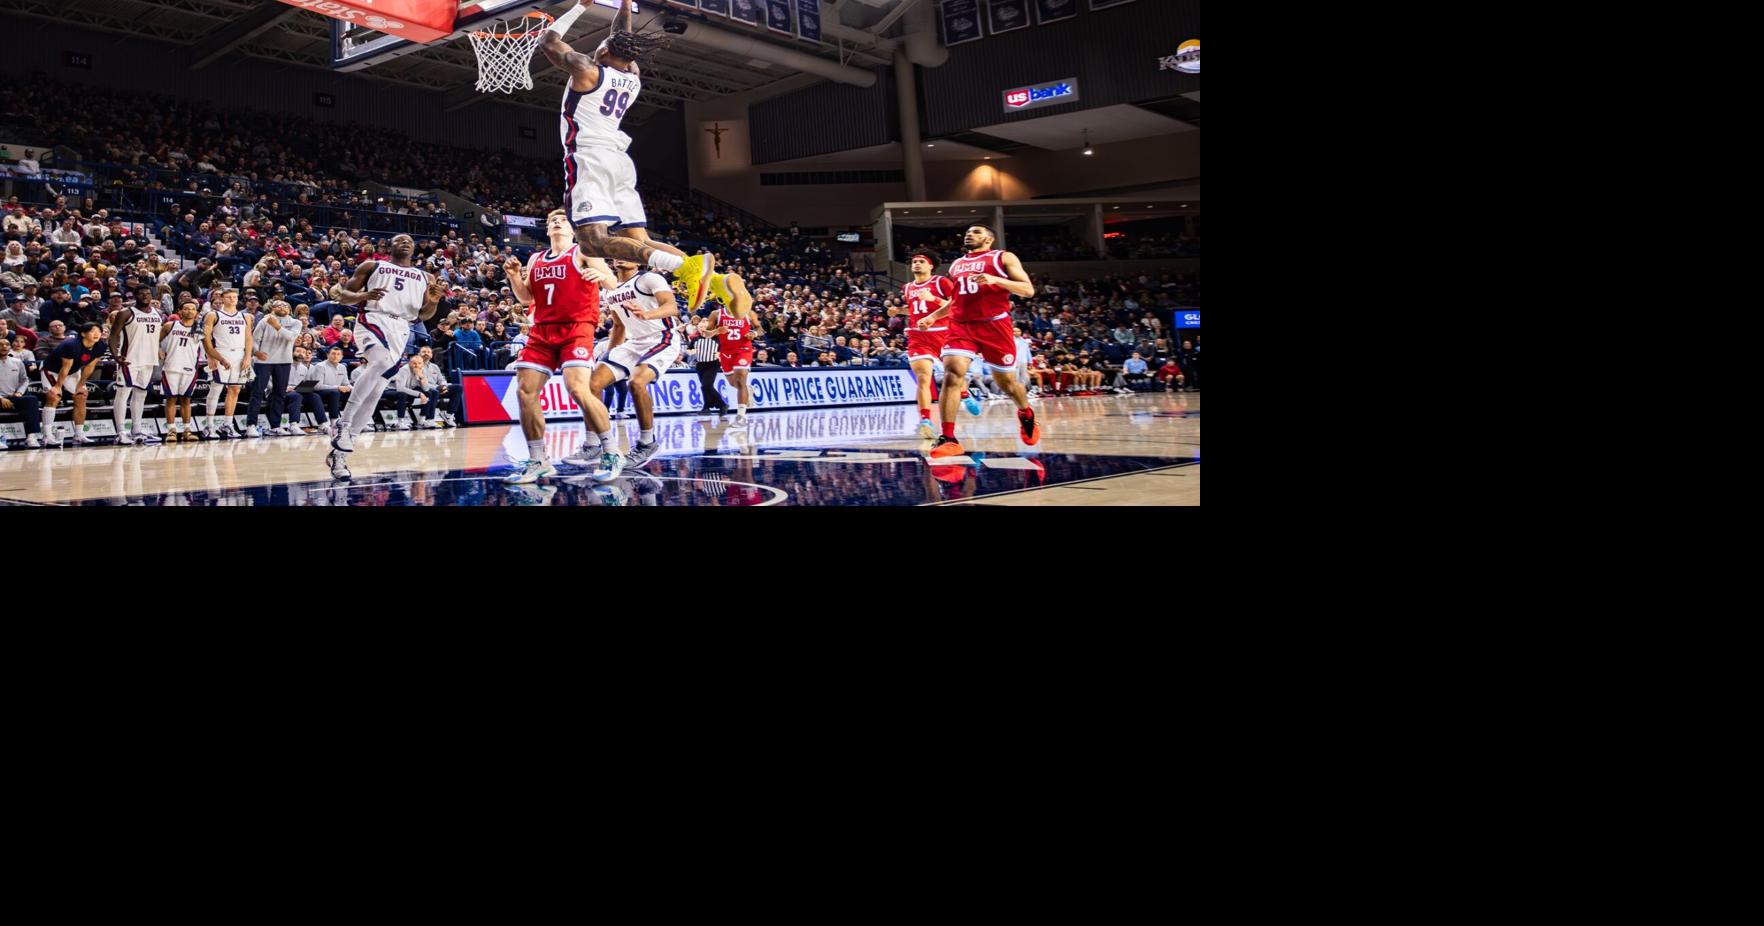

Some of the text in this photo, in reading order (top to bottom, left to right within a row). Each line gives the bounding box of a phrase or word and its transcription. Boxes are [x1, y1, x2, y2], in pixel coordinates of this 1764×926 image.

[1029, 82, 1073, 101] bank
[599, 88, 630, 119] 99
[379, 267, 422, 282] GONZAGA
[534, 264, 567, 282] LMU
[953, 261, 986, 276] LMU
[394, 277, 405, 291] 5
[957, 275, 979, 295] 16
[543, 283, 555, 305] 7
[608, 290, 637, 305] ONZAGA
[912, 300, 928, 315] 14
[145, 324, 156, 334] 13
[228, 326, 240, 335] 33
[722, 319, 744, 328] LMU
[179, 337, 188, 347] 11
[727, 328, 741, 341] 25
[688, 379, 704, 406] &
[751, 378, 779, 403] OW
[782, 376, 824, 401] PRICE
[826, 375, 905, 399] GUARANTEE
